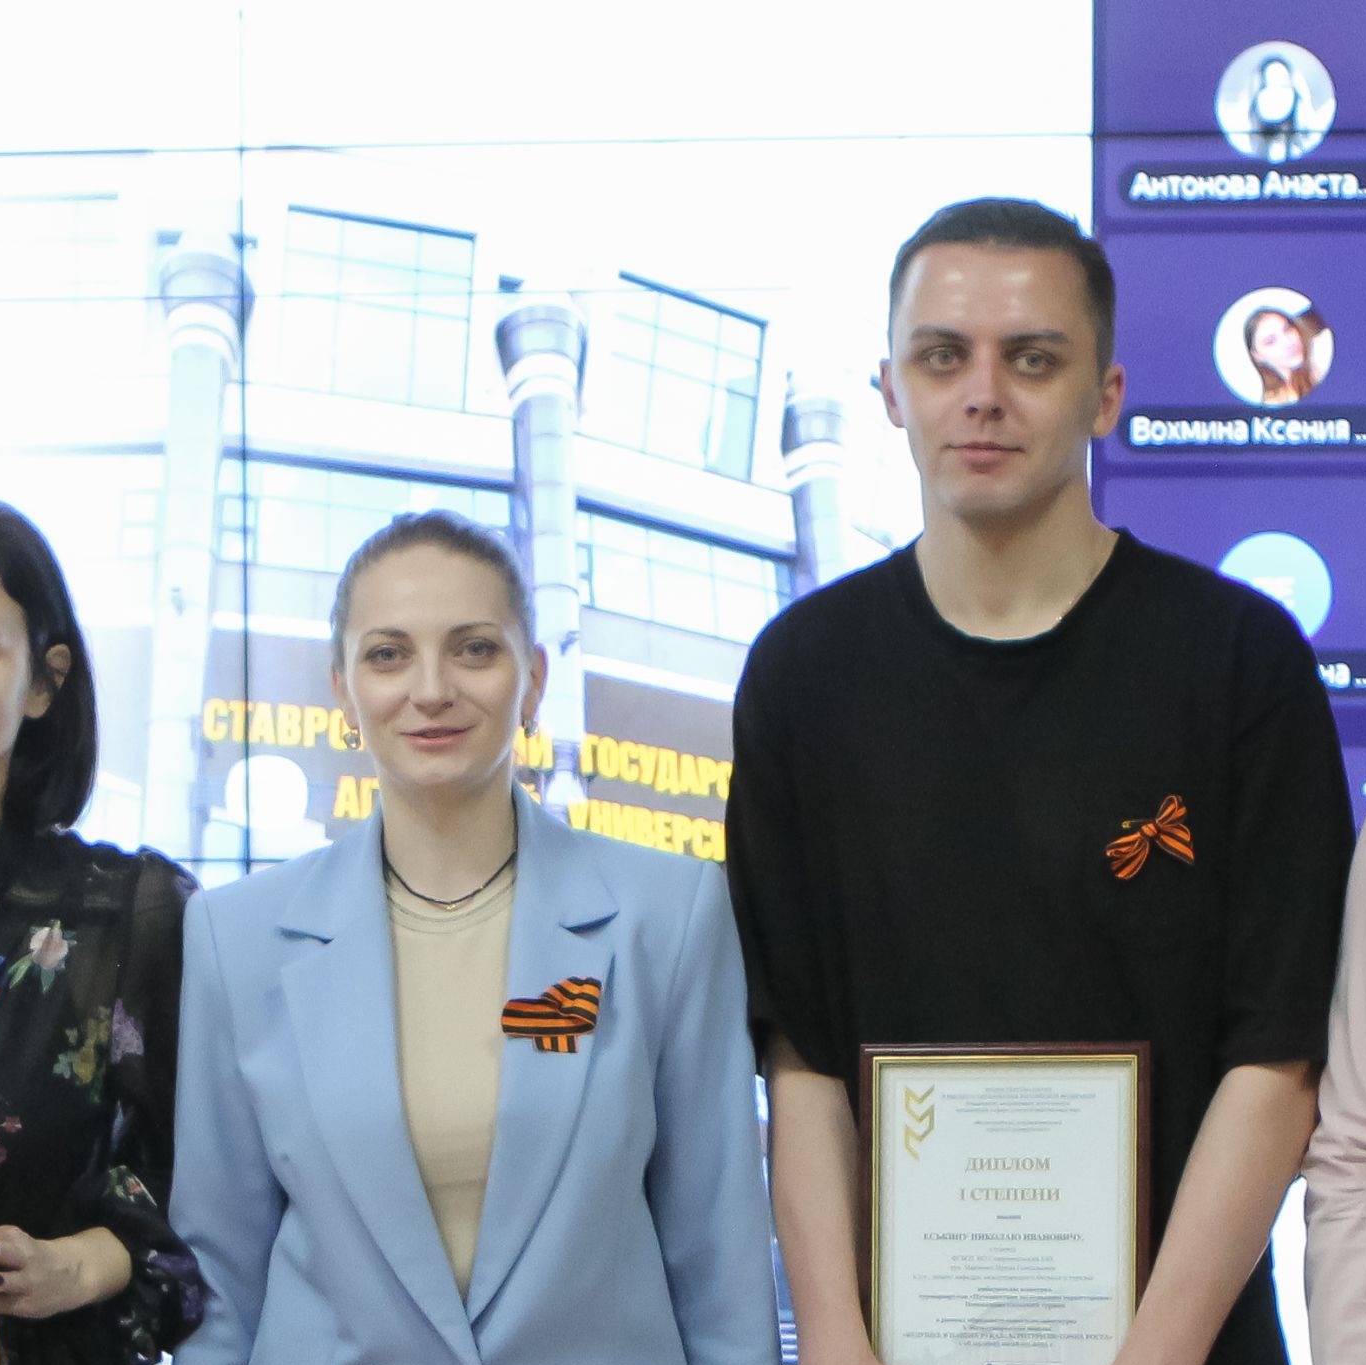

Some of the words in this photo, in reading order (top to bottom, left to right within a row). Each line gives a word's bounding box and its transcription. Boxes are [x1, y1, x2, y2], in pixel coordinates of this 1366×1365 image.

[1129, 171, 1261, 200] Антонова
[1130, 415, 1249, 446] Вохмина
[1251, 416, 1351, 446] Ксения
[203, 698, 352, 751] СТАВРО
[965, 1157, 1052, 1173] ДИПЛОМ
[970, 1187, 1061, 1201] СТЕПЕНИ
